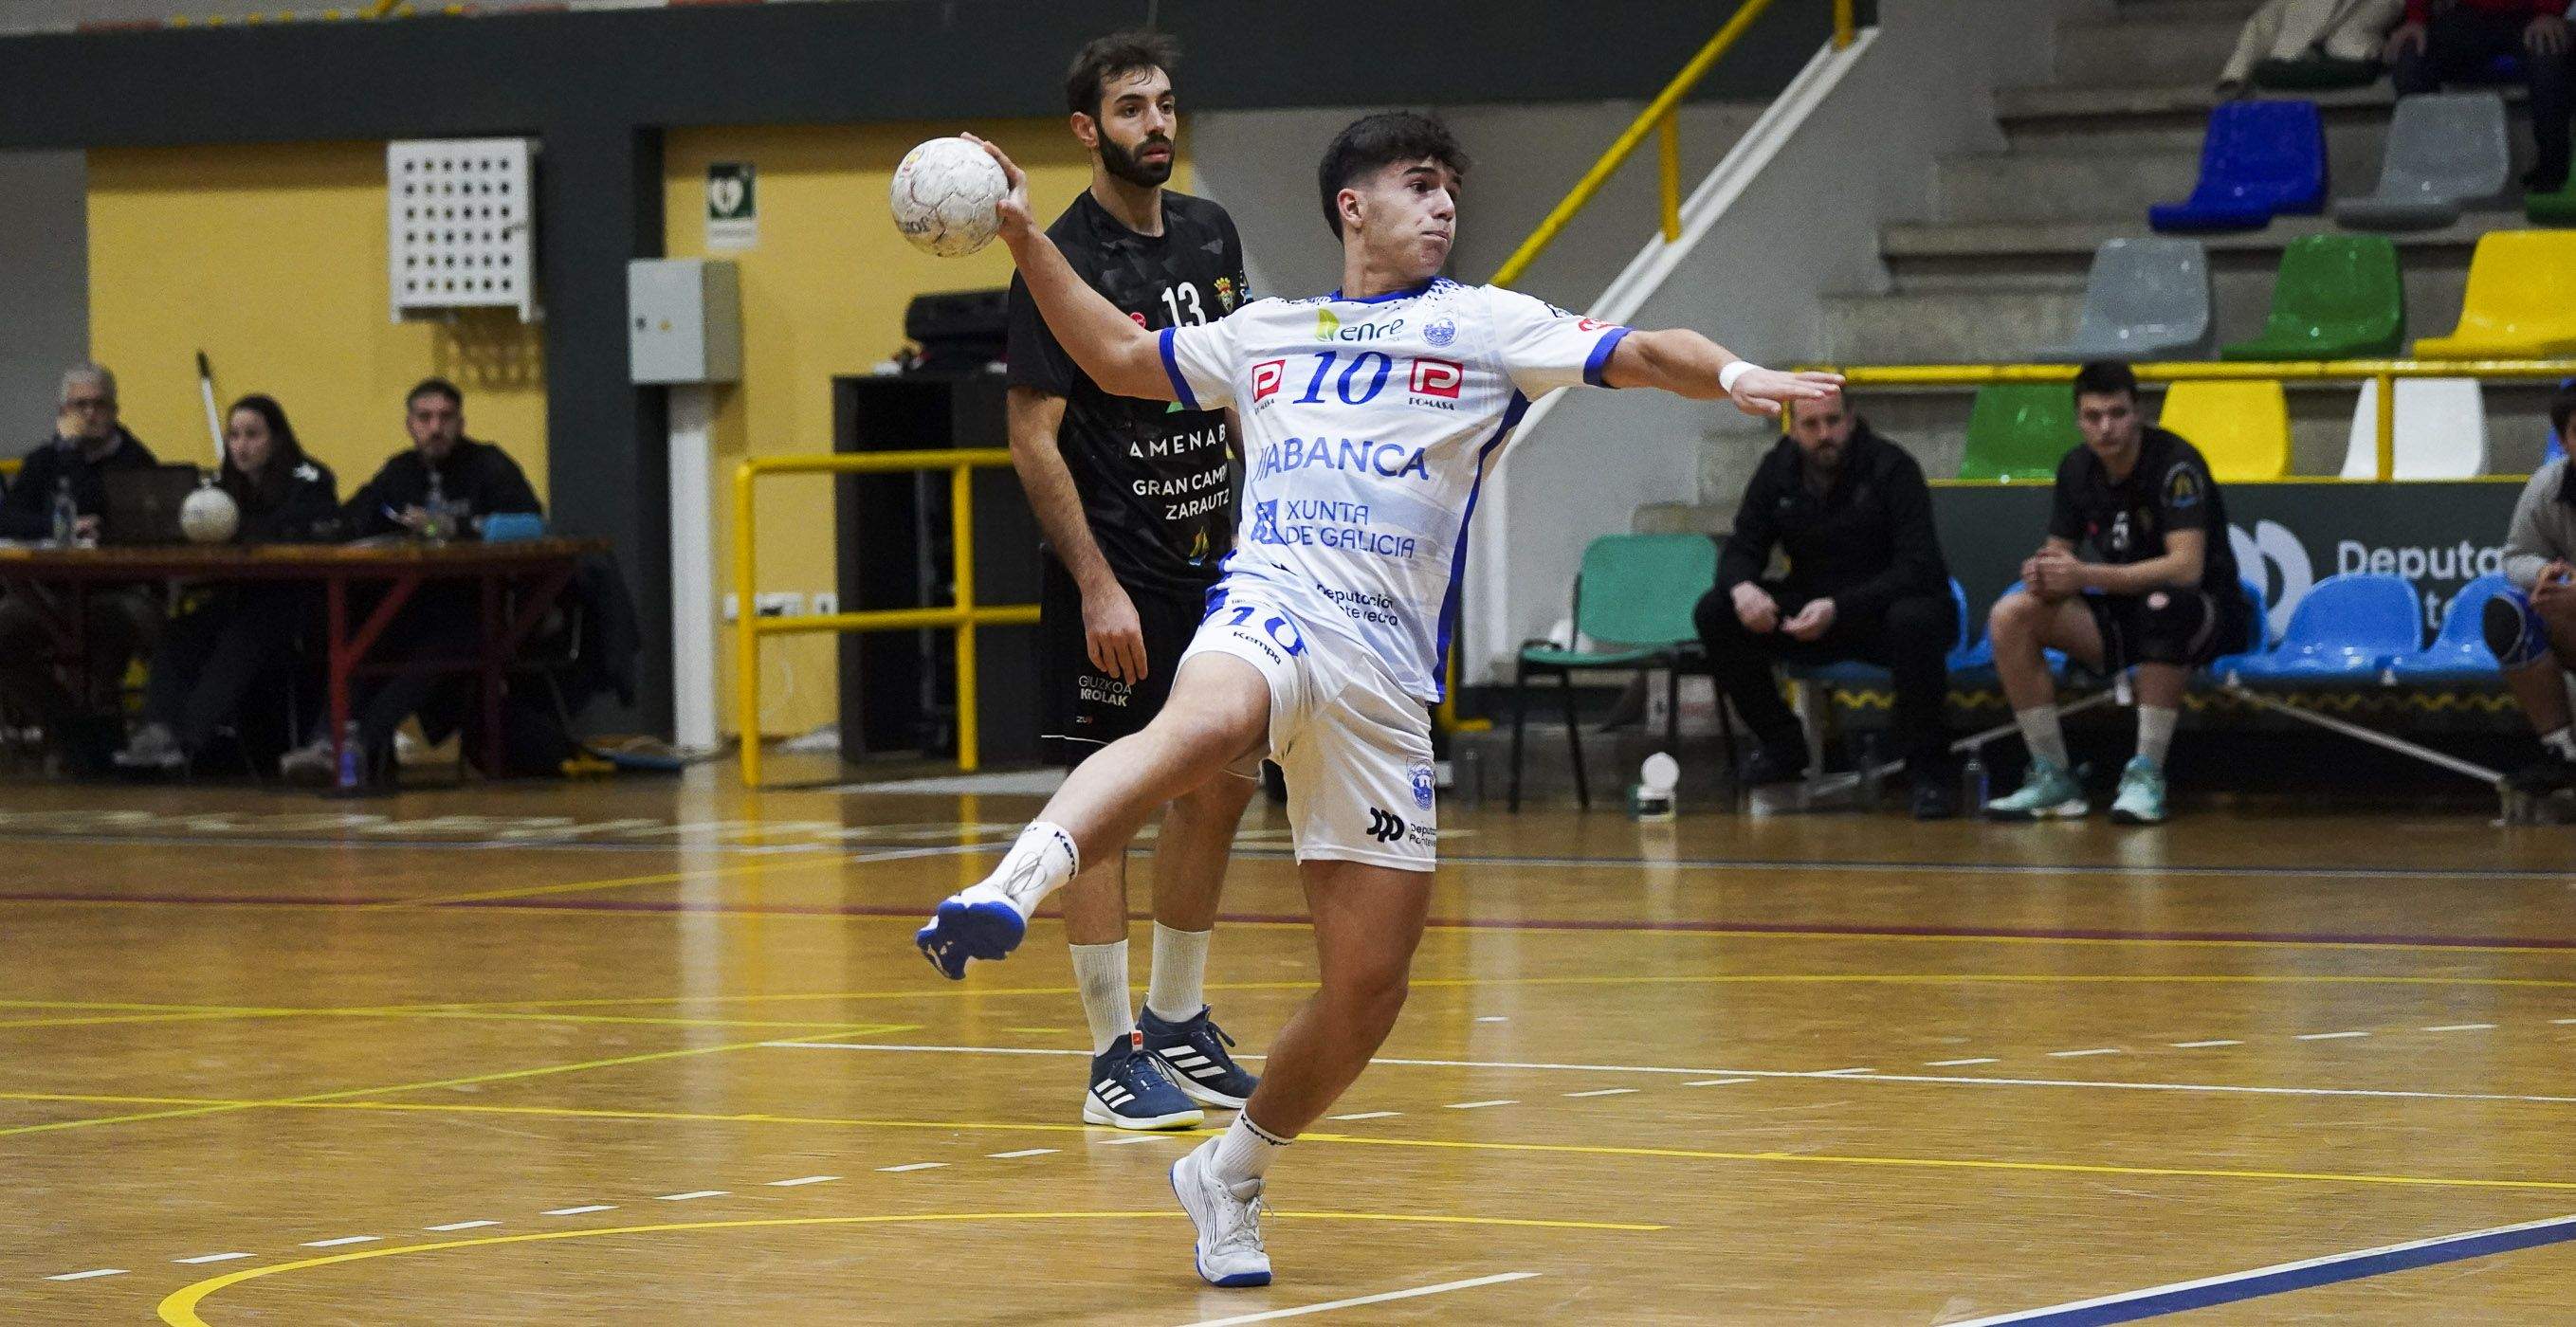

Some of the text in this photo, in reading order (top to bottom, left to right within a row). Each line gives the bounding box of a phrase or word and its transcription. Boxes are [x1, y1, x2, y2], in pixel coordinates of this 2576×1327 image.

[1160, 282, 1207, 328] 13
[1292, 350, 1393, 406] 10
[1132, 477, 1189, 496] GRAN
[1165, 488, 1231, 520] ZARAUTZ
[1287, 500, 1370, 526] XUNTA
[1286, 525, 1416, 559] DE GALICIA
